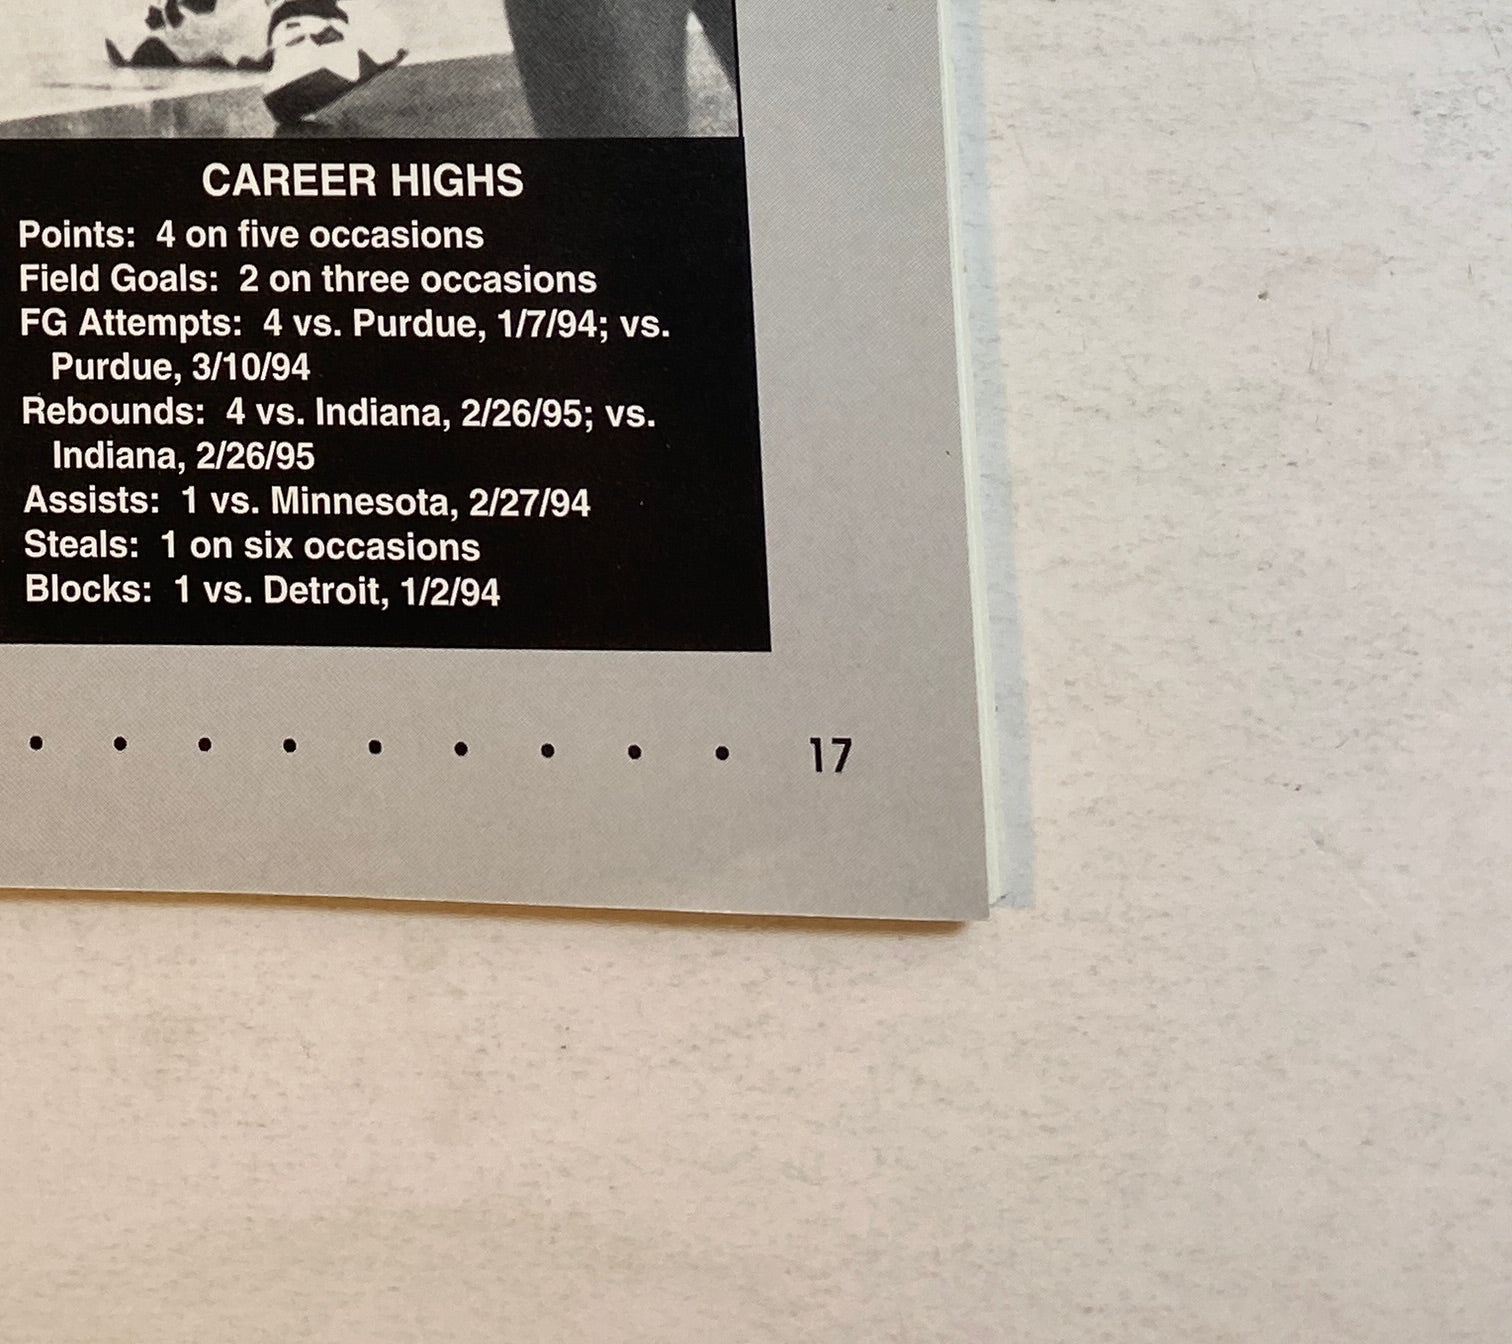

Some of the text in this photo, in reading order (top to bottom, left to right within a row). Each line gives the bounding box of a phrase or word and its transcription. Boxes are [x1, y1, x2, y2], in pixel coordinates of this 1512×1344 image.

[202, 162, 524, 197] CAREER HIGHS
[19, 218, 484, 249] Points: 4 on five occasions
[20, 262, 597, 294] Field Goals: 2 on three occasions
[21, 307, 670, 345] FG Attempts: 4 vs. Purdue, 1/7/94; vs.
[52, 351, 311, 388] Purdue, 3/10/94
[22, 395, 655, 433] Rebounds: 4 vs. Indiana, 2/26/95; vs.
[53, 440, 315, 476] Indiana, 2/26/95
[23, 484, 591, 522] Assists: 1 vs. Minnesota, 2/27/94
[24, 528, 481, 562] Steals: 1 on six occasions
[26, 573, 501, 611] Blocks: 1 vs. Detroit, 1/2/94
[809, 737, 853, 773] 17
